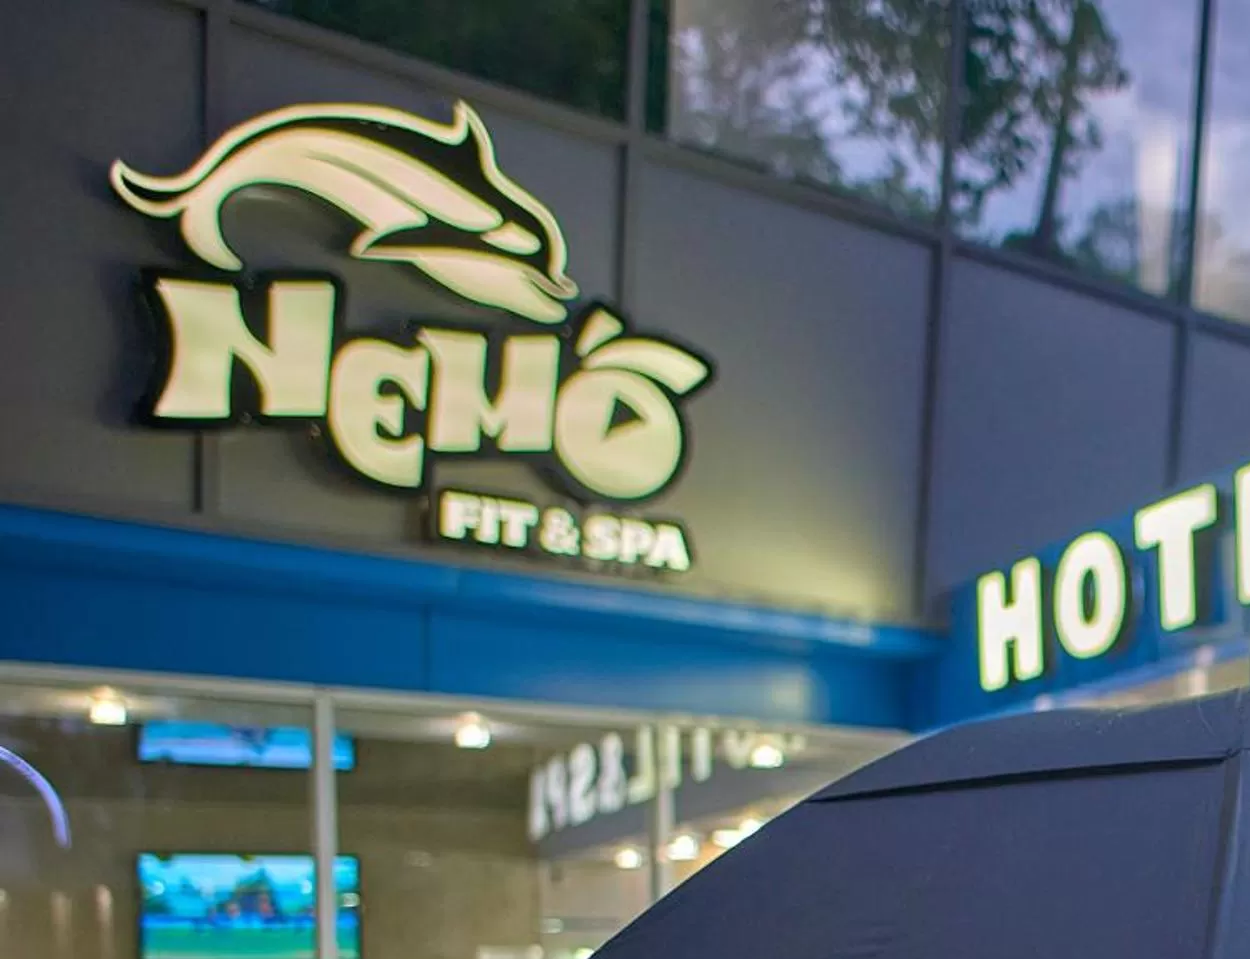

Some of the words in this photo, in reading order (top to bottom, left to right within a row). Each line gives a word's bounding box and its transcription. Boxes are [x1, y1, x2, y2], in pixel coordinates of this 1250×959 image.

[153, 278, 709, 500] NEMO
[440, 490, 539, 548] FIT
[540, 507, 580, 556] &
[582, 515, 691, 572] SPA
